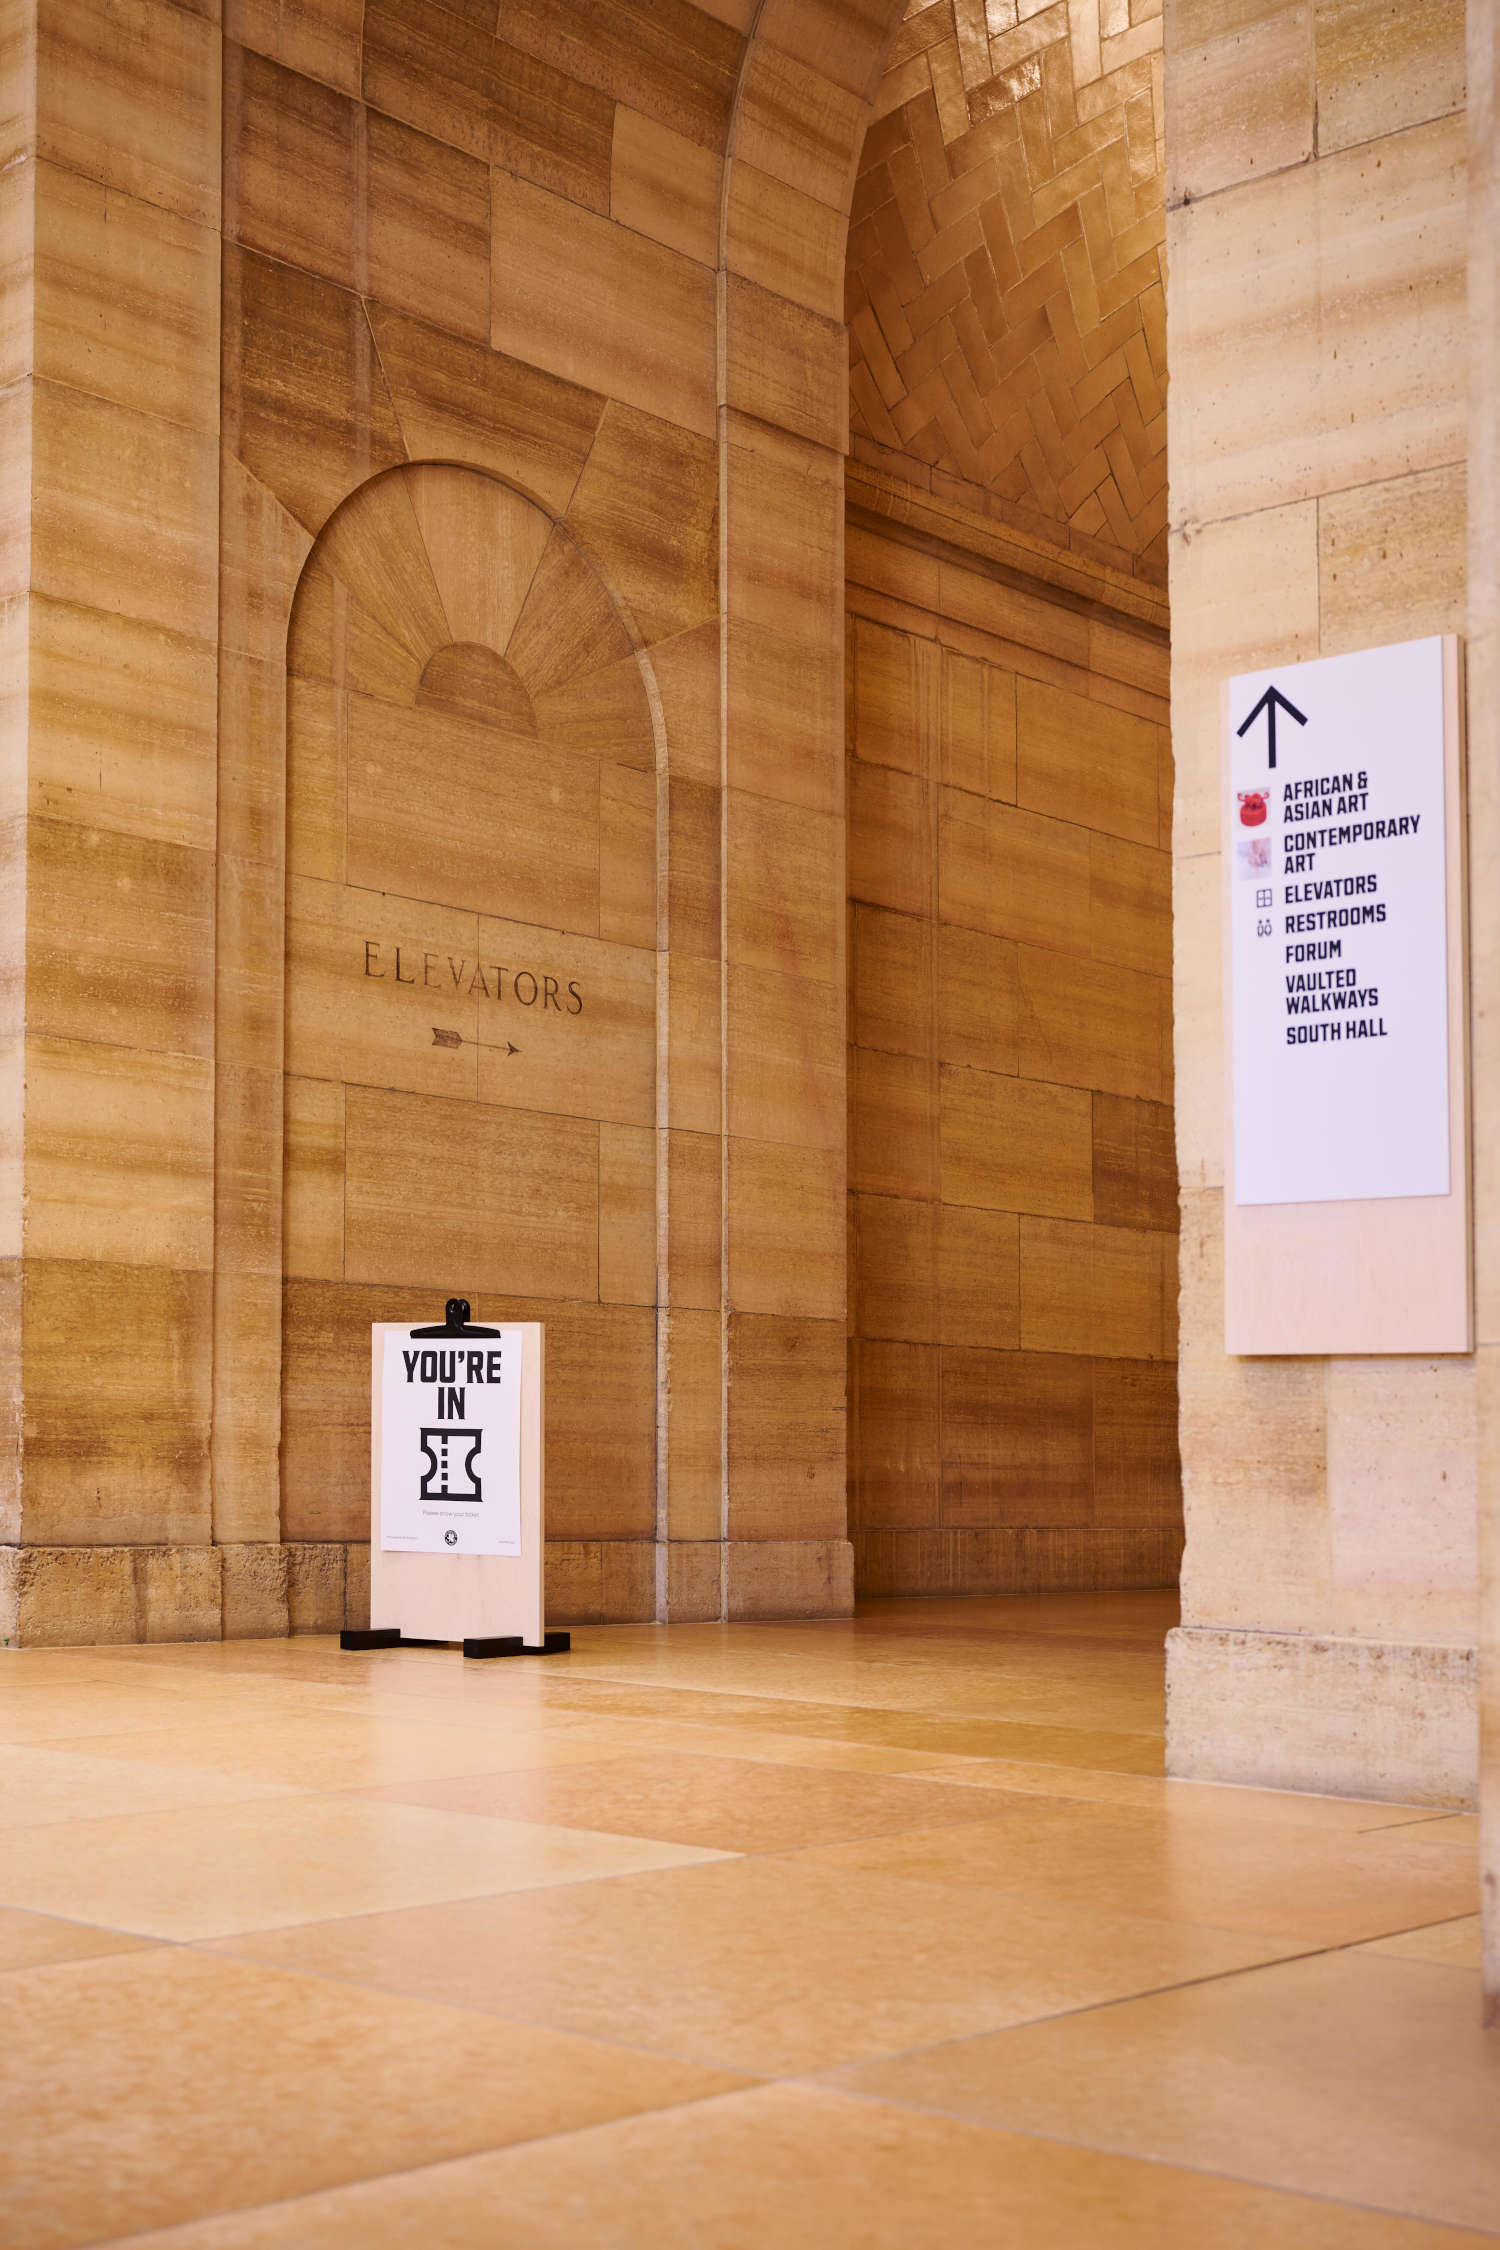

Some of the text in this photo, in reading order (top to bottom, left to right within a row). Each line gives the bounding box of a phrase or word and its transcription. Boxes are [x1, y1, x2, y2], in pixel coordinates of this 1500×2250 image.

[1283, 770, 1368, 802] AFRICAN &
[1283, 792, 1369, 824] ASIAN ART
[1283, 814, 1421, 853] CONTEMPORARY
[1284, 852, 1316, 875] ART
[1285, 874, 1378, 905] ELEVATORS
[1285, 903, 1387, 934] RESTROOMS
[1285, 939, 1342, 964] FORUM
[364, 940, 583, 1015] ELEVATORS
[1285, 968, 1357, 994] VAULTED
[1285, 988, 1379, 1015] WALKWAYS
[1286, 1017, 1388, 1046] SOUTH HALL
[402, 1350, 502, 1384] YOU'RE
[437, 1387, 466, 1420] IN
